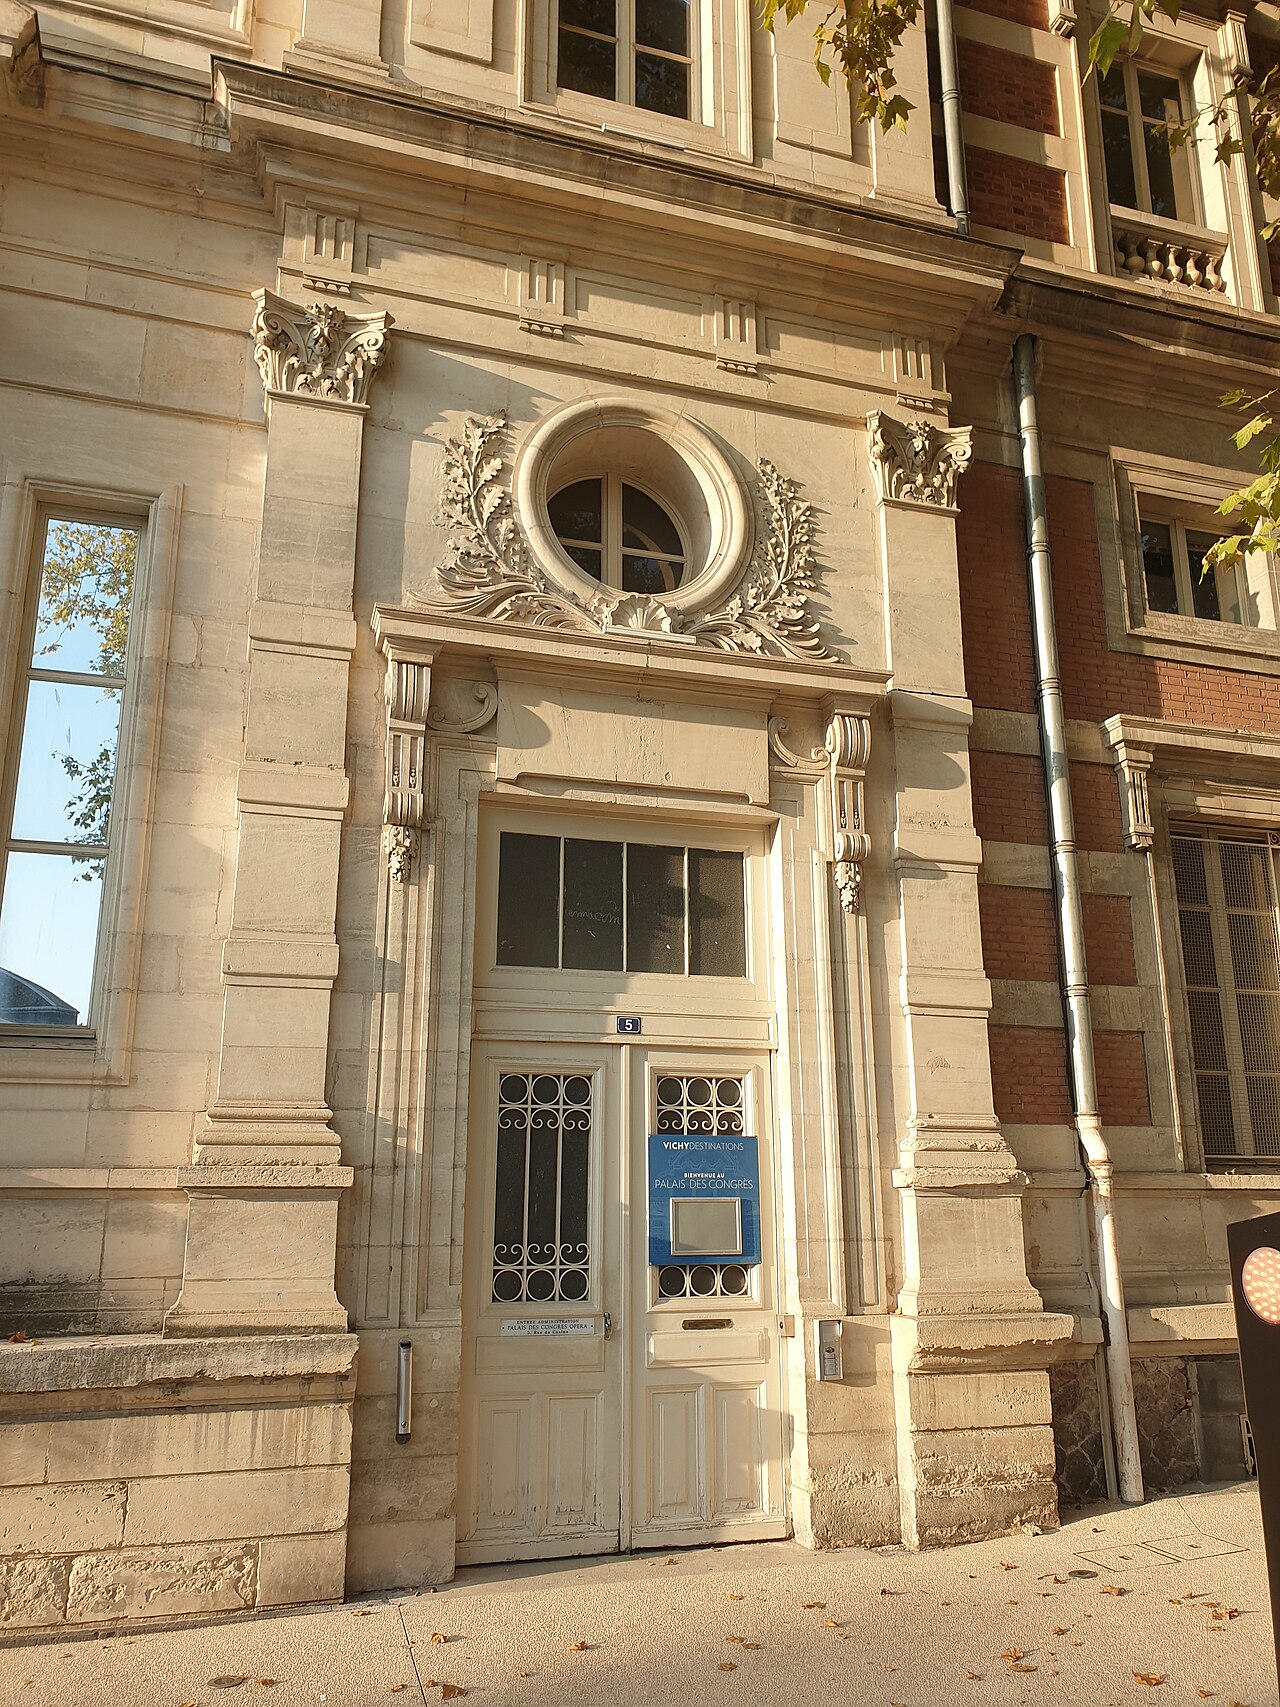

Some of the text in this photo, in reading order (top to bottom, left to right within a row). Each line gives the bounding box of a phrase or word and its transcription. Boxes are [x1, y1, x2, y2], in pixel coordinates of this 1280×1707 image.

[625, 1020, 632, 1030] 5
[663, 1142, 744, 1151] VICHYDESTINATIONS
[654, 1178, 754, 1190] PALAIS DES CONGRÈS
